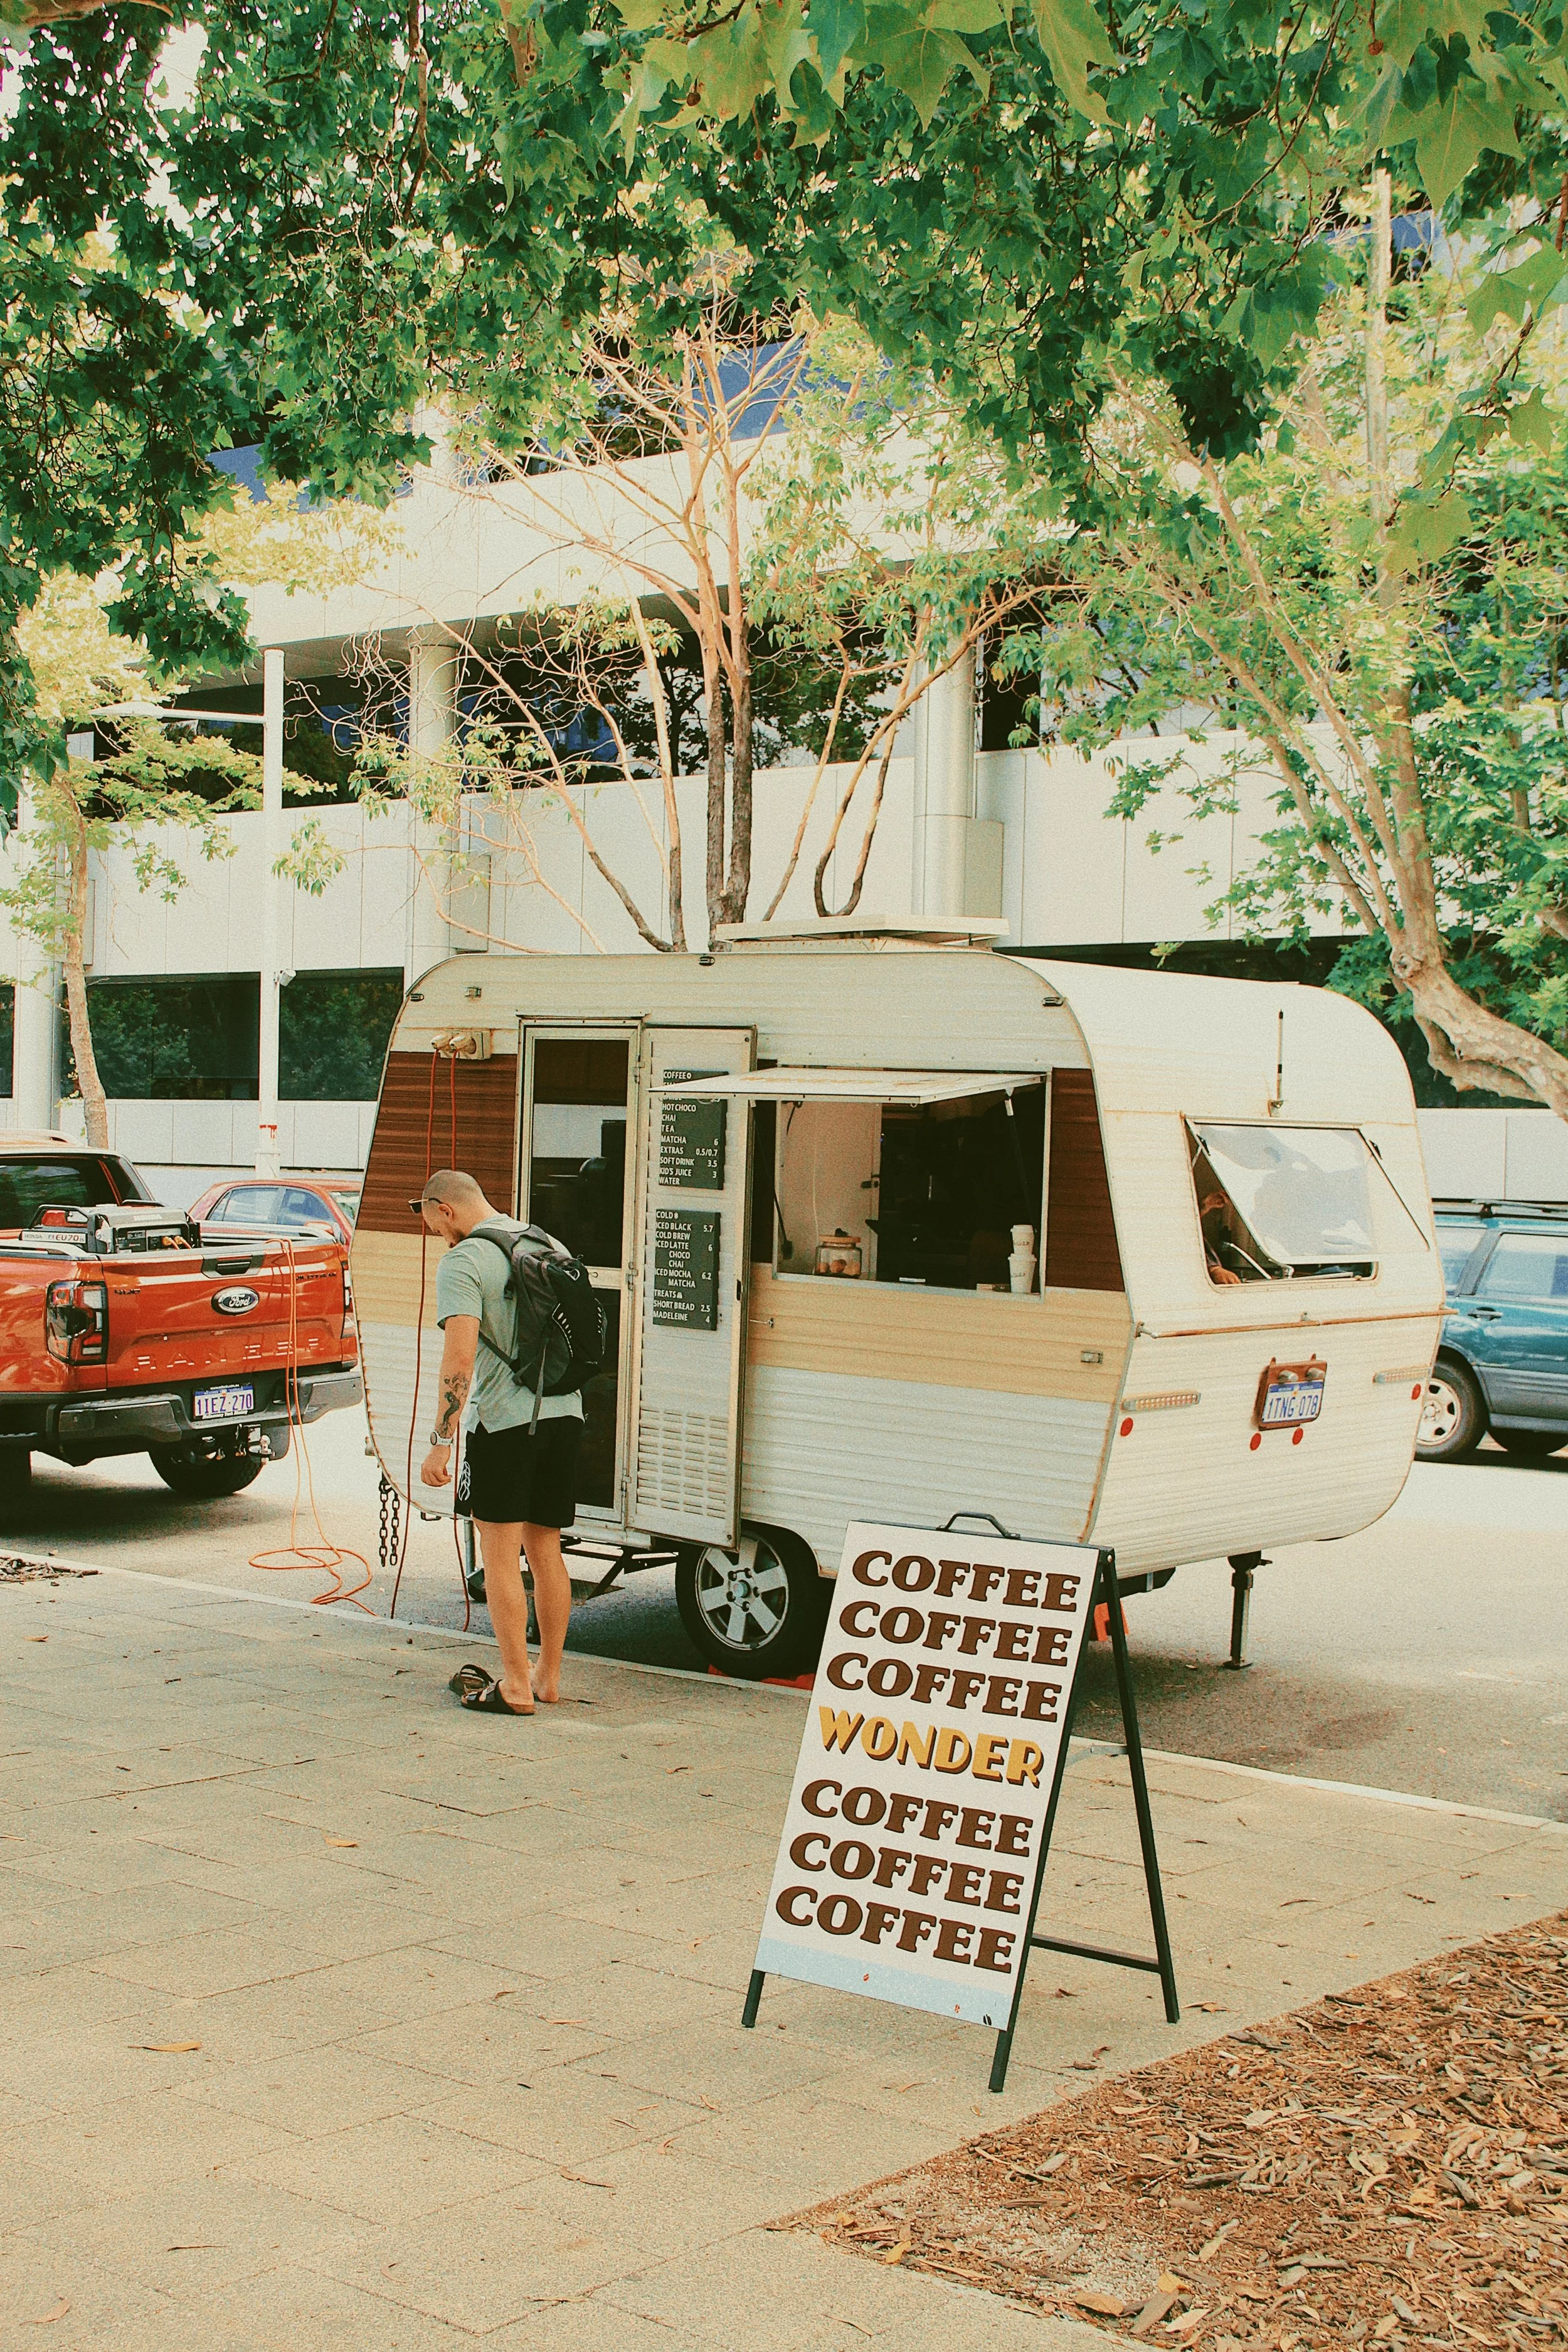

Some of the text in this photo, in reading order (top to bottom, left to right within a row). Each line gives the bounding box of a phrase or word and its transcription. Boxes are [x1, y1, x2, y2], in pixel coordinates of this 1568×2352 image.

[660, 1135, 686, 1143] MATCHA
[696, 1148, 718, 1157] 0.5/0.7
[660, 1157, 675, 1165] SOFT
[675, 1158, 694, 1166] DRINK
[674, 1168, 692, 1177] JUICE
[659, 1176, 680, 1185] WATER
[656, 1211, 674, 1219] COLD
[656, 1221, 669, 1229] ICED
[670, 1222, 692, 1231] BLACK
[655, 1231, 690, 1240] COLD BREW
[656, 1240, 669, 1248] ICED
[669, 1241, 689, 1249] LATTE
[669, 1251, 690, 1259] CHOCO
[655, 1268, 711, 1280] ICED MOCHA 6.2
[668, 1278, 696, 1288] MATCHA
[654, 1289, 676, 1298] TREATS
[229, 1294, 251, 1307] Ford
[653, 1310, 688, 1321] MADELEINE
[852, 1550, 1081, 1612] COFFEE
[839, 1601, 1073, 1667] COFFEE
[827, 1653, 1061, 1723] COFFEE
[818, 1706, 1044, 1788] WONDER
[802, 1779, 1034, 1857] COFFEE
[790, 1833, 1024, 1915] COFFEE
[776, 1886, 1015, 1974] COFFEE
